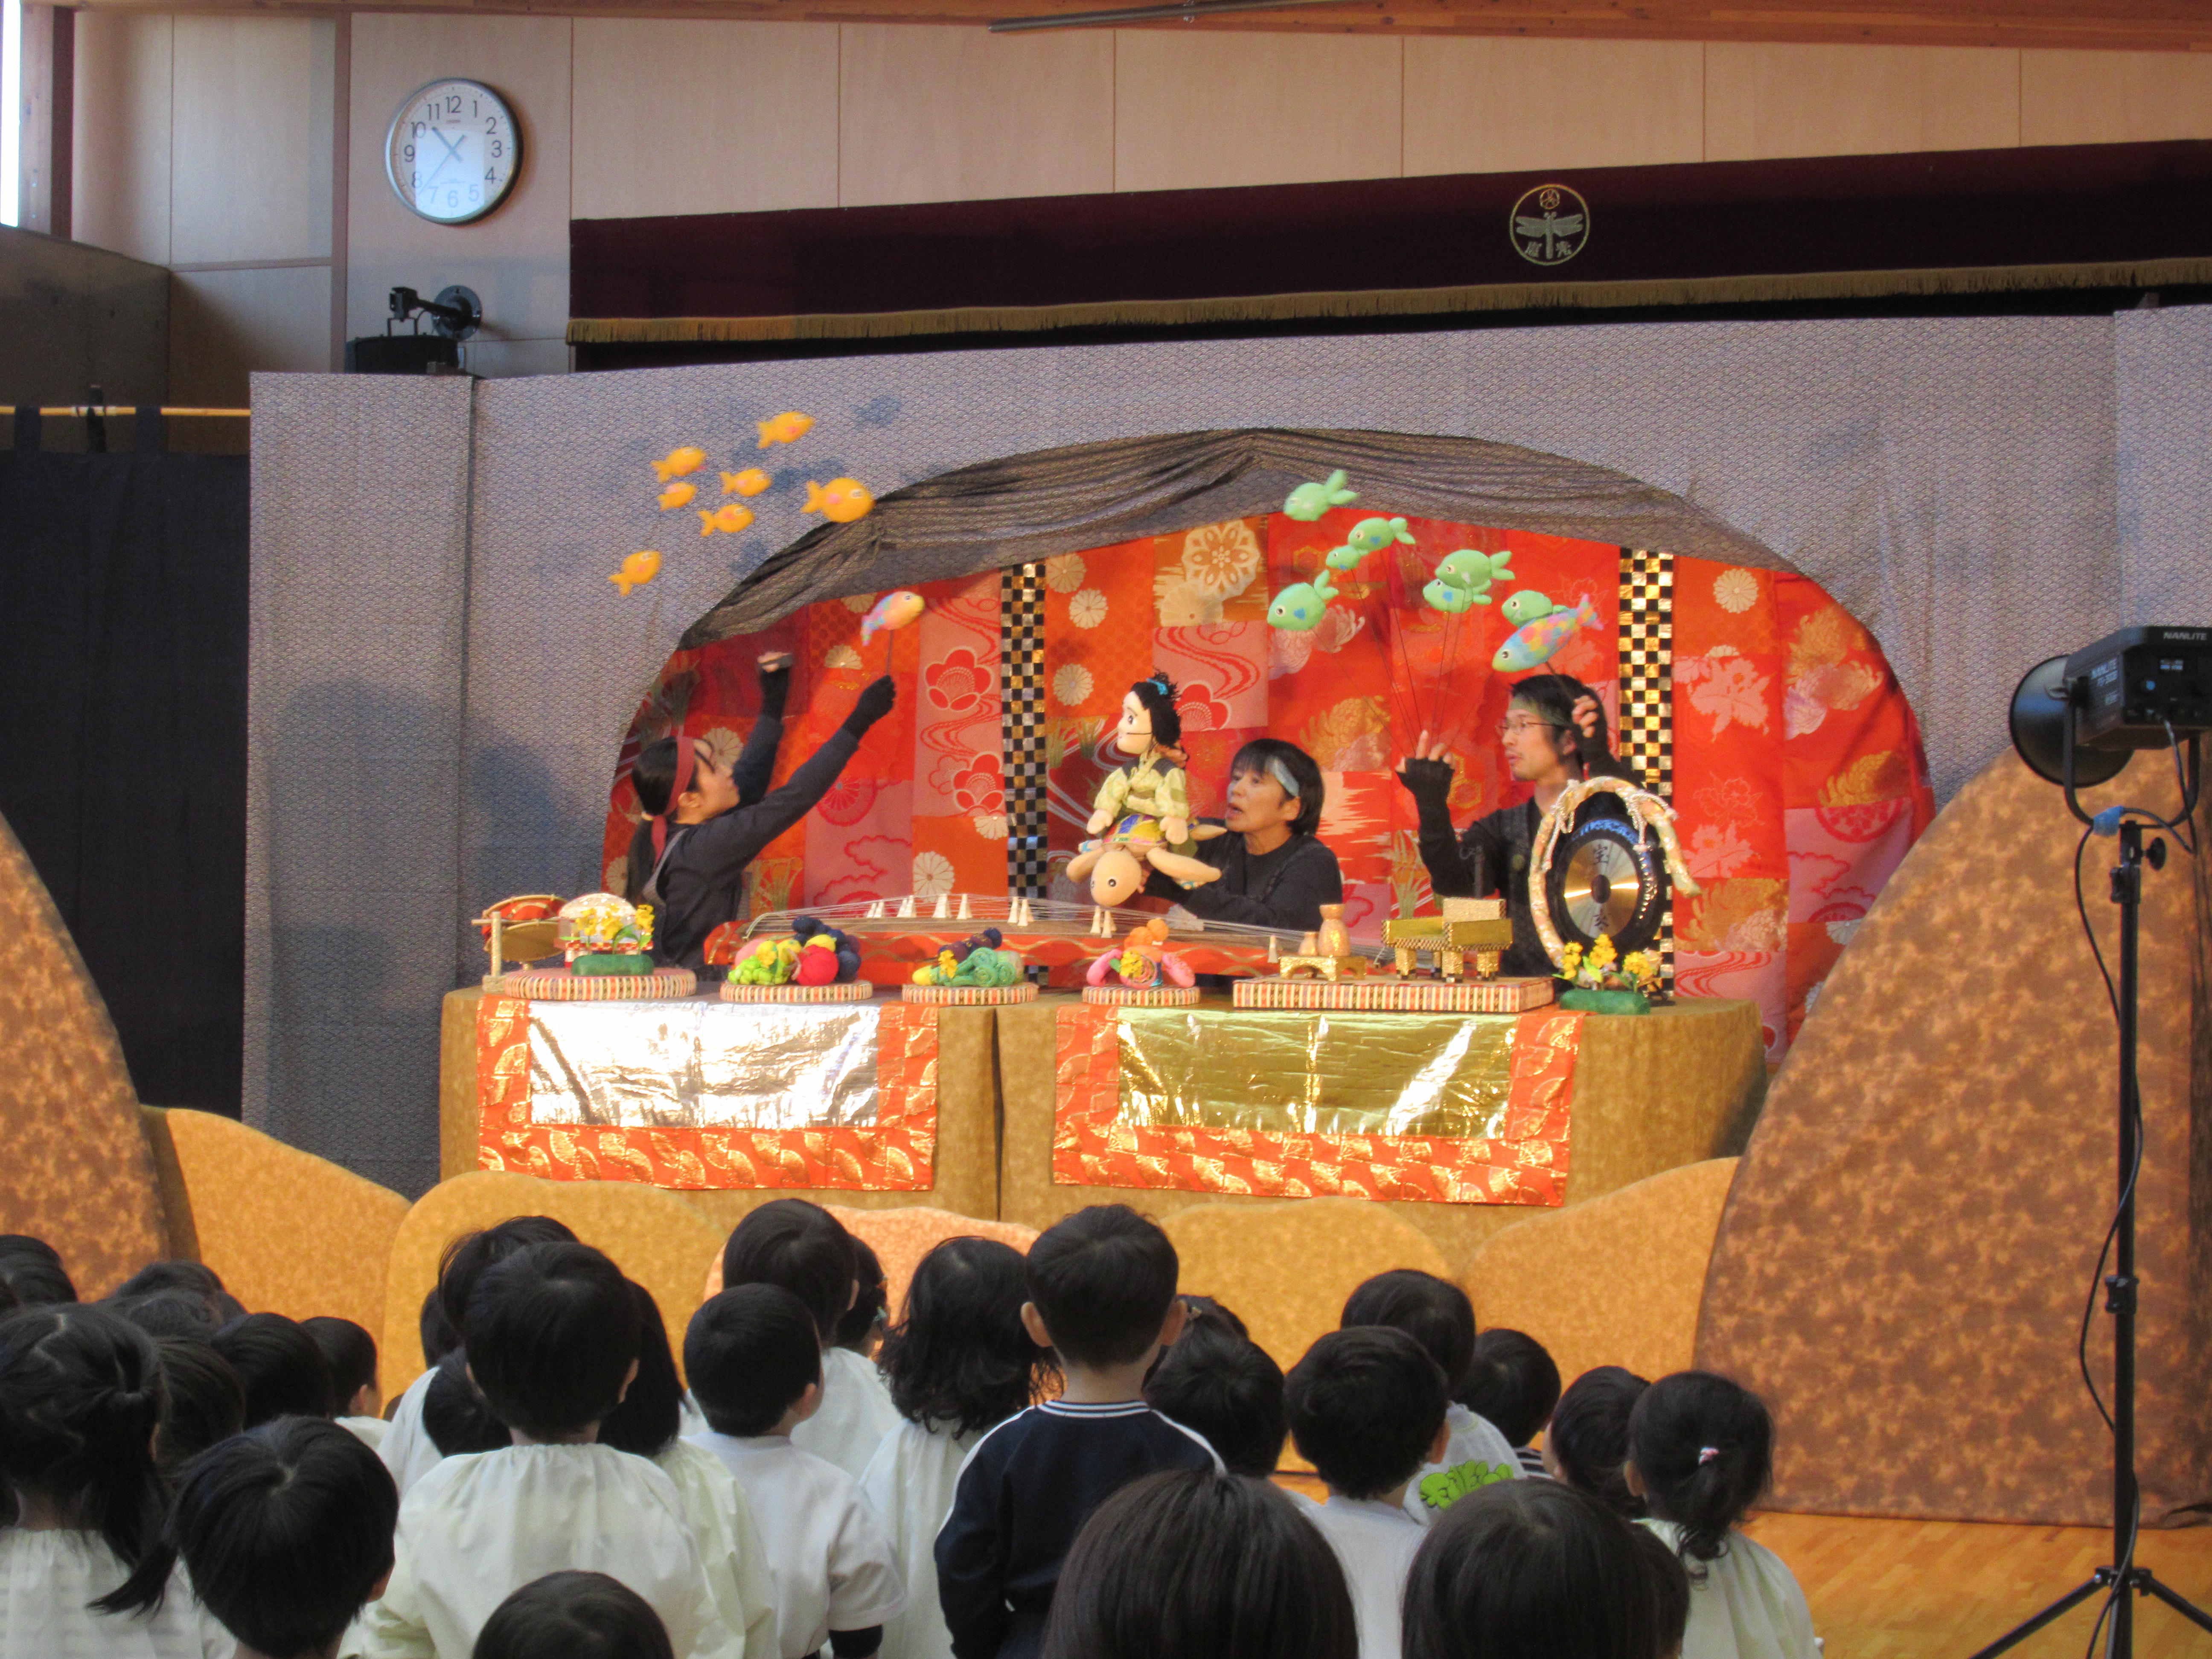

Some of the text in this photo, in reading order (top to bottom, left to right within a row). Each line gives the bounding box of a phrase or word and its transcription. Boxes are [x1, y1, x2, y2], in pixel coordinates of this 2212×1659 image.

[427, 103, 440, 120] 11
[445, 95, 462, 114] 12
[473, 100, 477, 118] 1
[410, 122, 426, 139] 10
[485, 116, 497, 135] 2
[404, 145, 415, 162] 9
[491, 140, 502, 158] 3
[412, 172, 422, 188] 8
[484, 166, 497, 184] 4
[427, 186, 439, 204] 7
[447, 190, 459, 208] 6
[469, 183, 479, 202] 5
[2163, 632, 2207, 640] NANLITE
